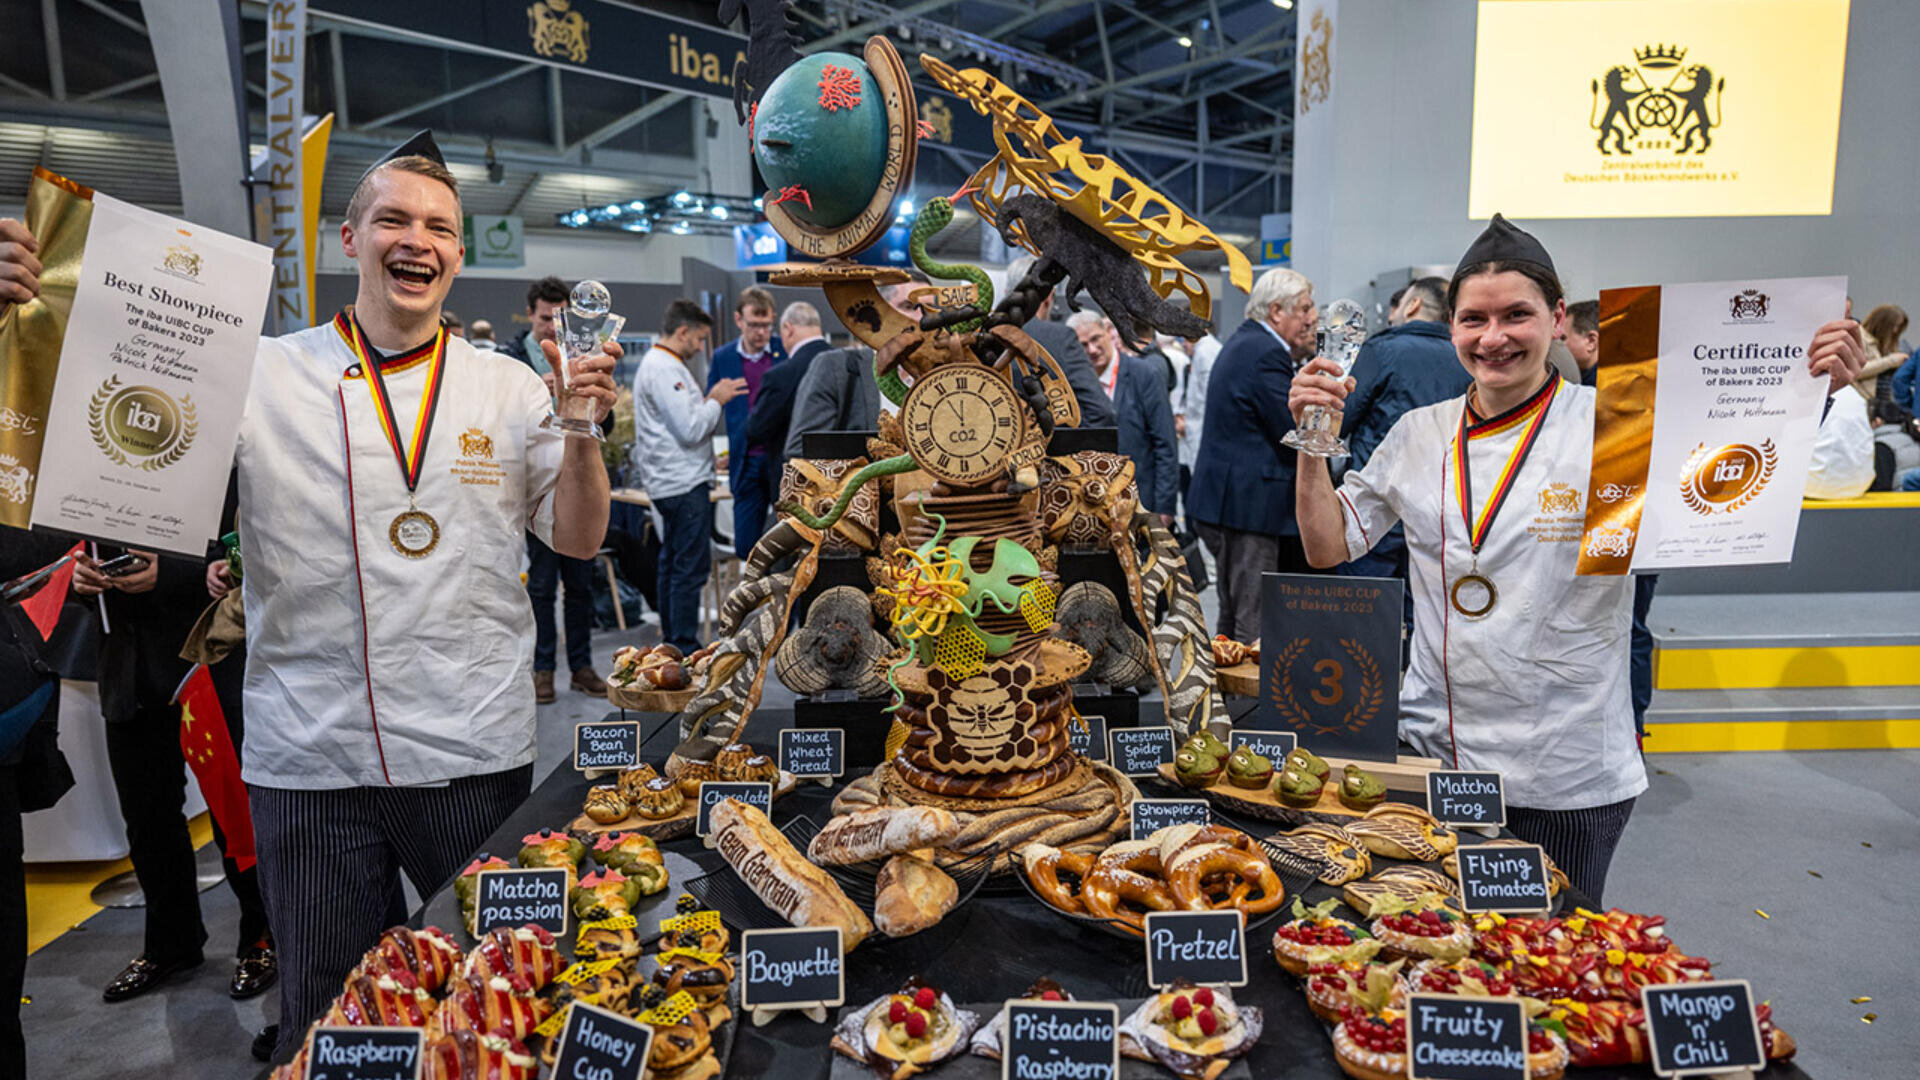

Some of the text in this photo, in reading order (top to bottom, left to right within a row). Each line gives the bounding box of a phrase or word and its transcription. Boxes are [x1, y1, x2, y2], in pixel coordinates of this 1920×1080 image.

[1601, 159, 1704, 171] Zentralverband des
[800, 123, 903, 255] THE ANIMAL WORLD
[1563, 173, 1620, 184] Deutschen
[103, 270, 144, 297] Best
[149, 286, 244, 329] Showpiece
[941, 287, 974, 305] SAVE
[126, 302, 215, 337] The iba UIBC CUP
[128, 317, 206, 347] of Bakers 2023
[115, 342, 147, 361] Nicole
[131, 334, 186, 359] Germany
[1693, 342, 1803, 361] Certificate
[110, 352, 147, 372] Patrick
[1701, 365, 1791, 376] The iba UIBC CUP
[1706, 376, 1783, 386] of Bakers 2023
[1048, 388, 1069, 420] OUR
[1716, 392, 1766, 406] Germany
[126, 401, 163, 434] iba
[1707, 408, 1737, 420] Nicole
[120, 434, 157, 451] Winner
[949, 428, 978, 443] CO2
[1713, 459, 1746, 483] iba
[1280, 584, 1382, 600] The iba UIBC CUP
[1286, 600, 1374, 614] of Bakers 2023
[1310, 658, 1344, 706] 3
[582, 727, 635, 740] Bacon-
[791, 731, 829, 743] Mixed
[1117, 731, 1171, 743] Chestnut
[590, 739, 624, 751] Bean
[788, 745, 834, 758] Wheat
[1125, 743, 1163, 757] Spider
[579, 752, 636, 767] Butterfly
[790, 758, 831, 772] Bread
[1127, 758, 1161, 771] Bread
[1436, 776, 1499, 795] Matcha
[1441, 798, 1486, 820] Frog
[716, 818, 747, 871] Team
[742, 852, 801, 917] Germany
[1466, 853, 1532, 880] Flying
[488, 876, 560, 900] Matcha
[1468, 879, 1546, 897] Tomatoes
[482, 901, 563, 927] passion
[1151, 927, 1240, 962] Pretzel
[746, 946, 840, 987] Baguette
[1660, 993, 1736, 1021] Mango
[1014, 1012, 1113, 1042] Pistachio
[1419, 1005, 1504, 1043] Fruity
[317, 1035, 417, 1068] Raspberry
[576, 1016, 636, 1067] Honey
[1415, 1041, 1525, 1070] Cheesecake
[1673, 1039, 1729, 1067] Chili
[573, 1056, 614, 1080] Cup
[1016, 1054, 1115, 1080] Raspberry
